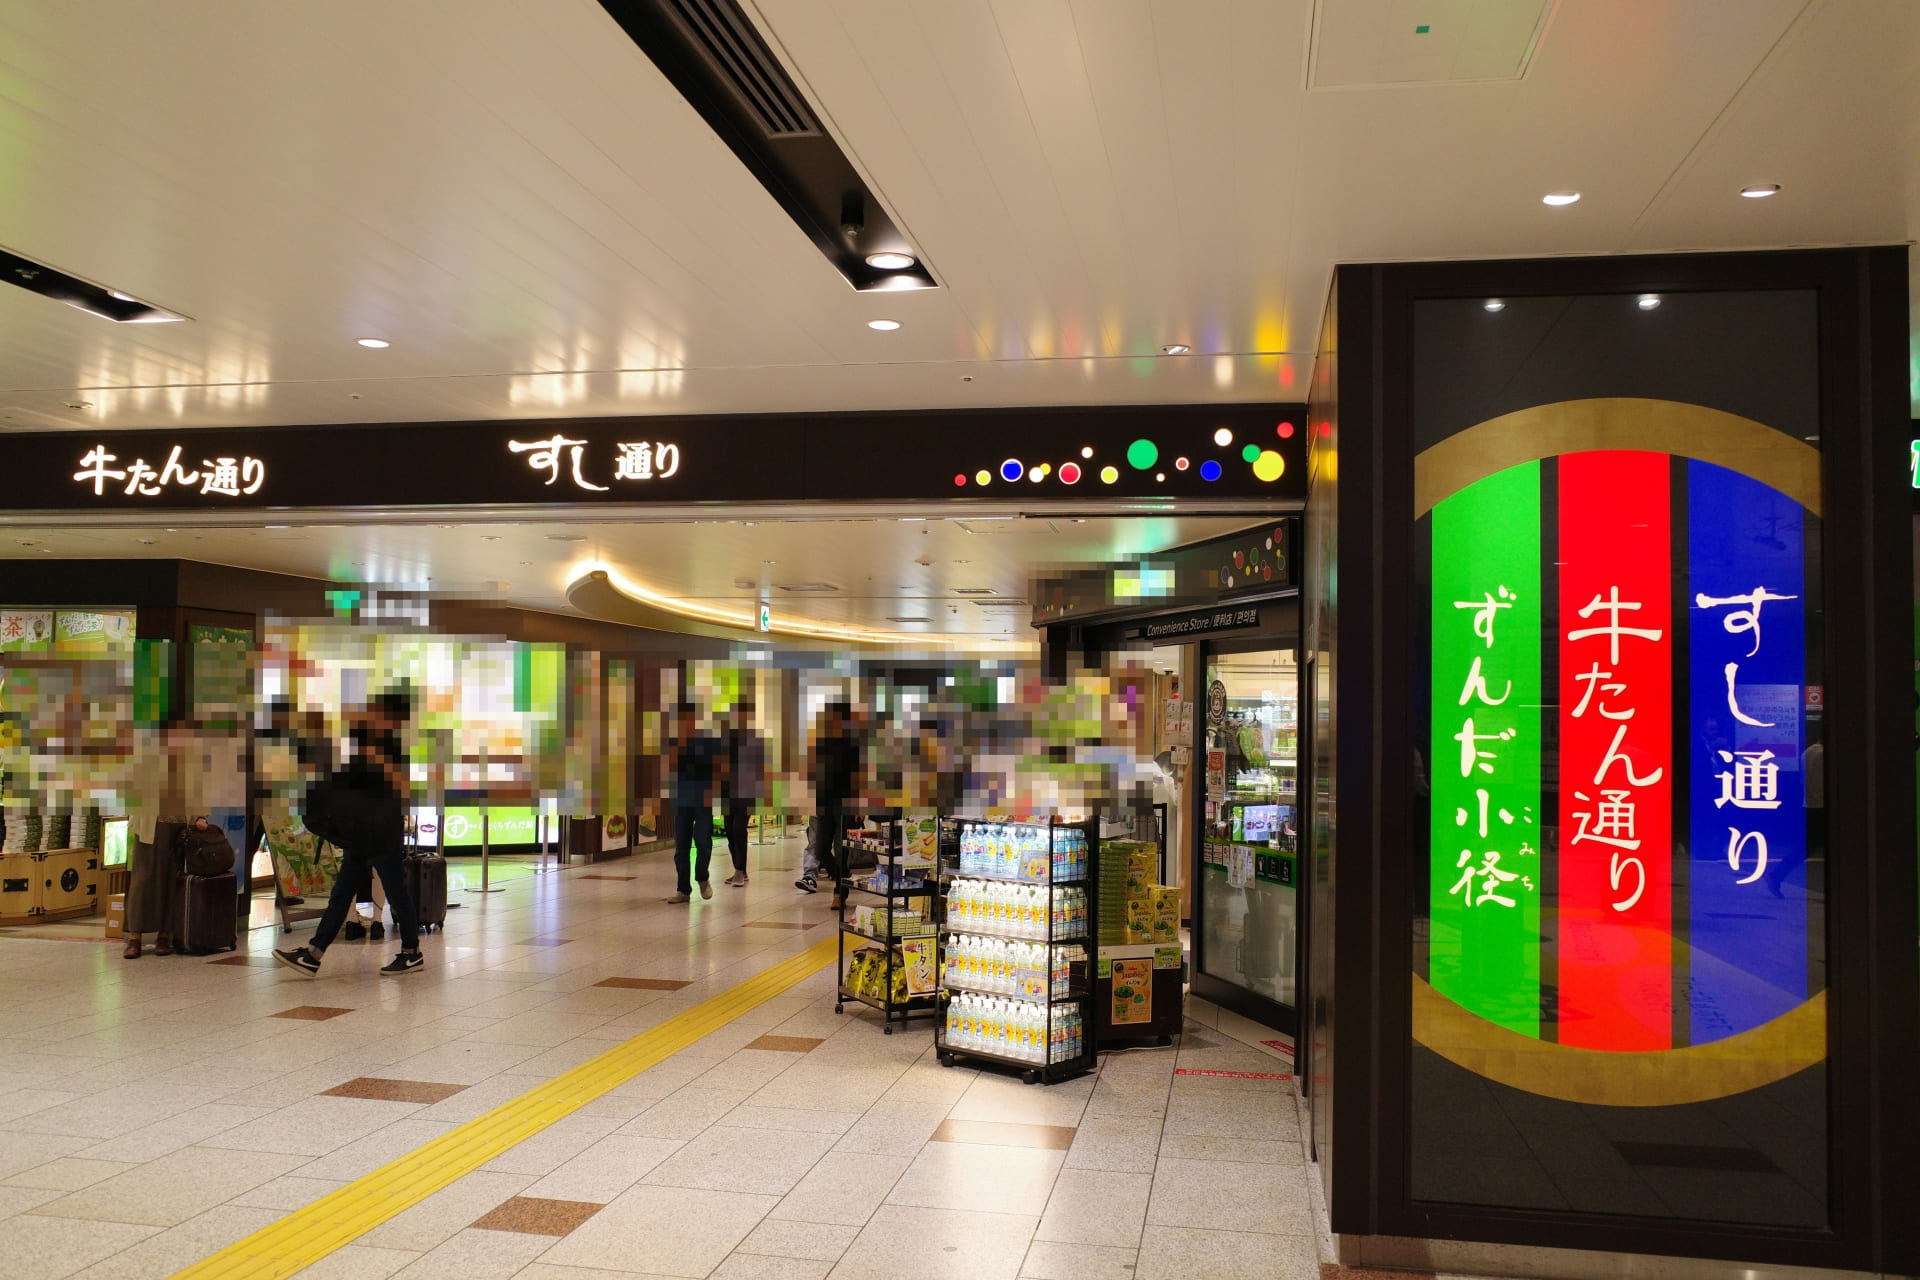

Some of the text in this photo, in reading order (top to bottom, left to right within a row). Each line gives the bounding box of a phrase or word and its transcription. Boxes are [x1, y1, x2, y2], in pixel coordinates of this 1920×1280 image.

[73, 445, 265, 497] 牛たん通り
[508, 434, 680, 491] すし通り
[1147, 621, 1188, 637] Convenience
[1189, 618, 1209, 631] Store
[1213, 612, 1232, 627] 便利店
[1236, 609, 1256, 625] 편의점
[1449, 586, 1519, 908] ずんだ小径
[1567, 585, 1663, 912] 牛たん通り
[1696, 585, 1798, 884] すし通り
[1519, 806, 1536, 891] こみち
